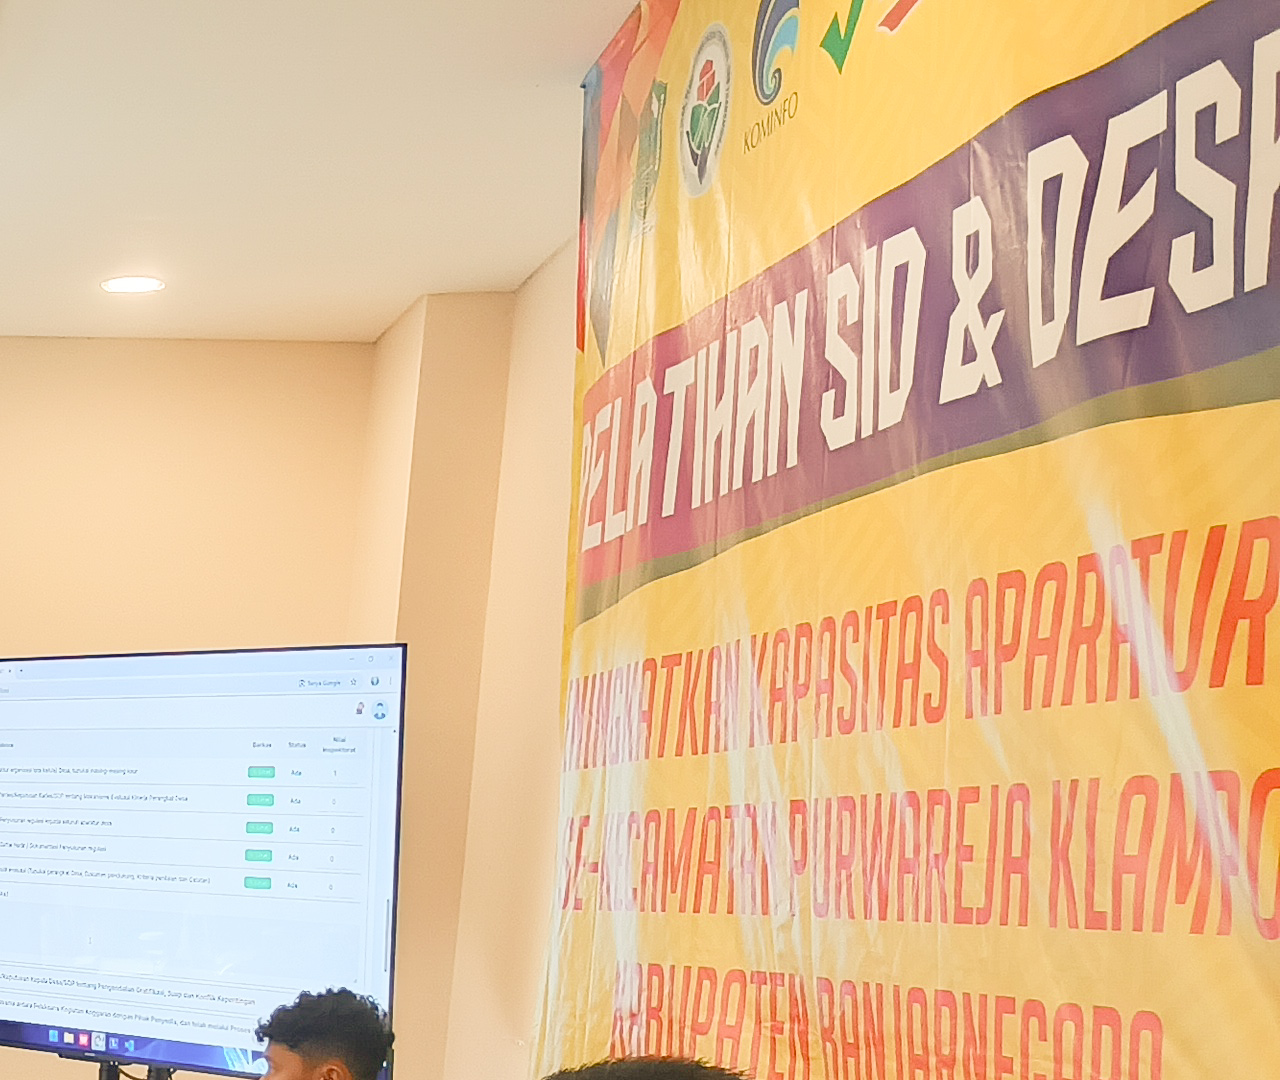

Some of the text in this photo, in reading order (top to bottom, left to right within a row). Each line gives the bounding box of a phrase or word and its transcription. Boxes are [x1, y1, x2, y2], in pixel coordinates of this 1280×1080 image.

[743, 91, 799, 154] KOMINFO
[820, 227, 926, 451] SID
[939, 196, 1006, 405] &
[749, 587, 949, 748] KAPASITAS
[965, 515, 1279, 719] APARATUR
[290, 769, 302, 777] Ada
[790, 782, 1031, 928] PURWAREJA
